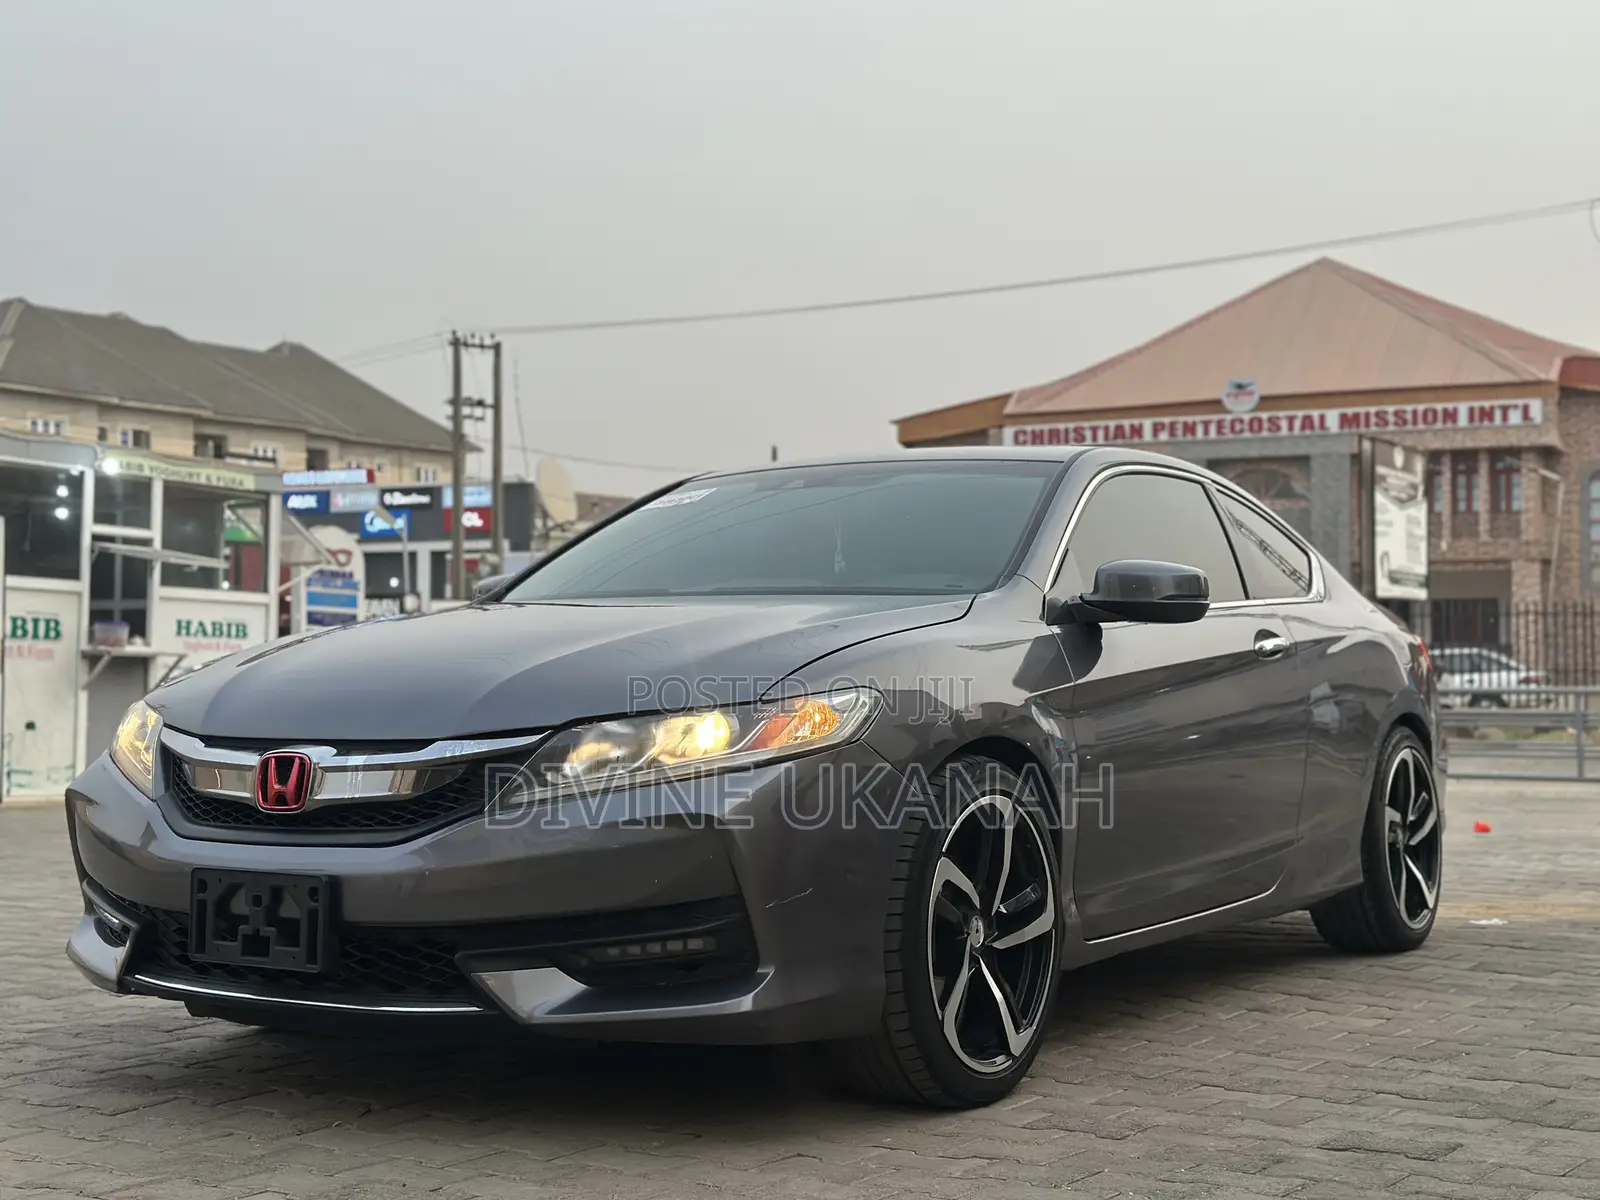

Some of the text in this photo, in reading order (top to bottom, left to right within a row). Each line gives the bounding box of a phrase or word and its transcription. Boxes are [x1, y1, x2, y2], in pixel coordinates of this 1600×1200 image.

[1013, 403, 1535, 446] CHRISTIAN PENTECOSTAL MISSION INT'L
[9, 615, 62, 641] BIB
[175, 619, 248, 639] HABIB
